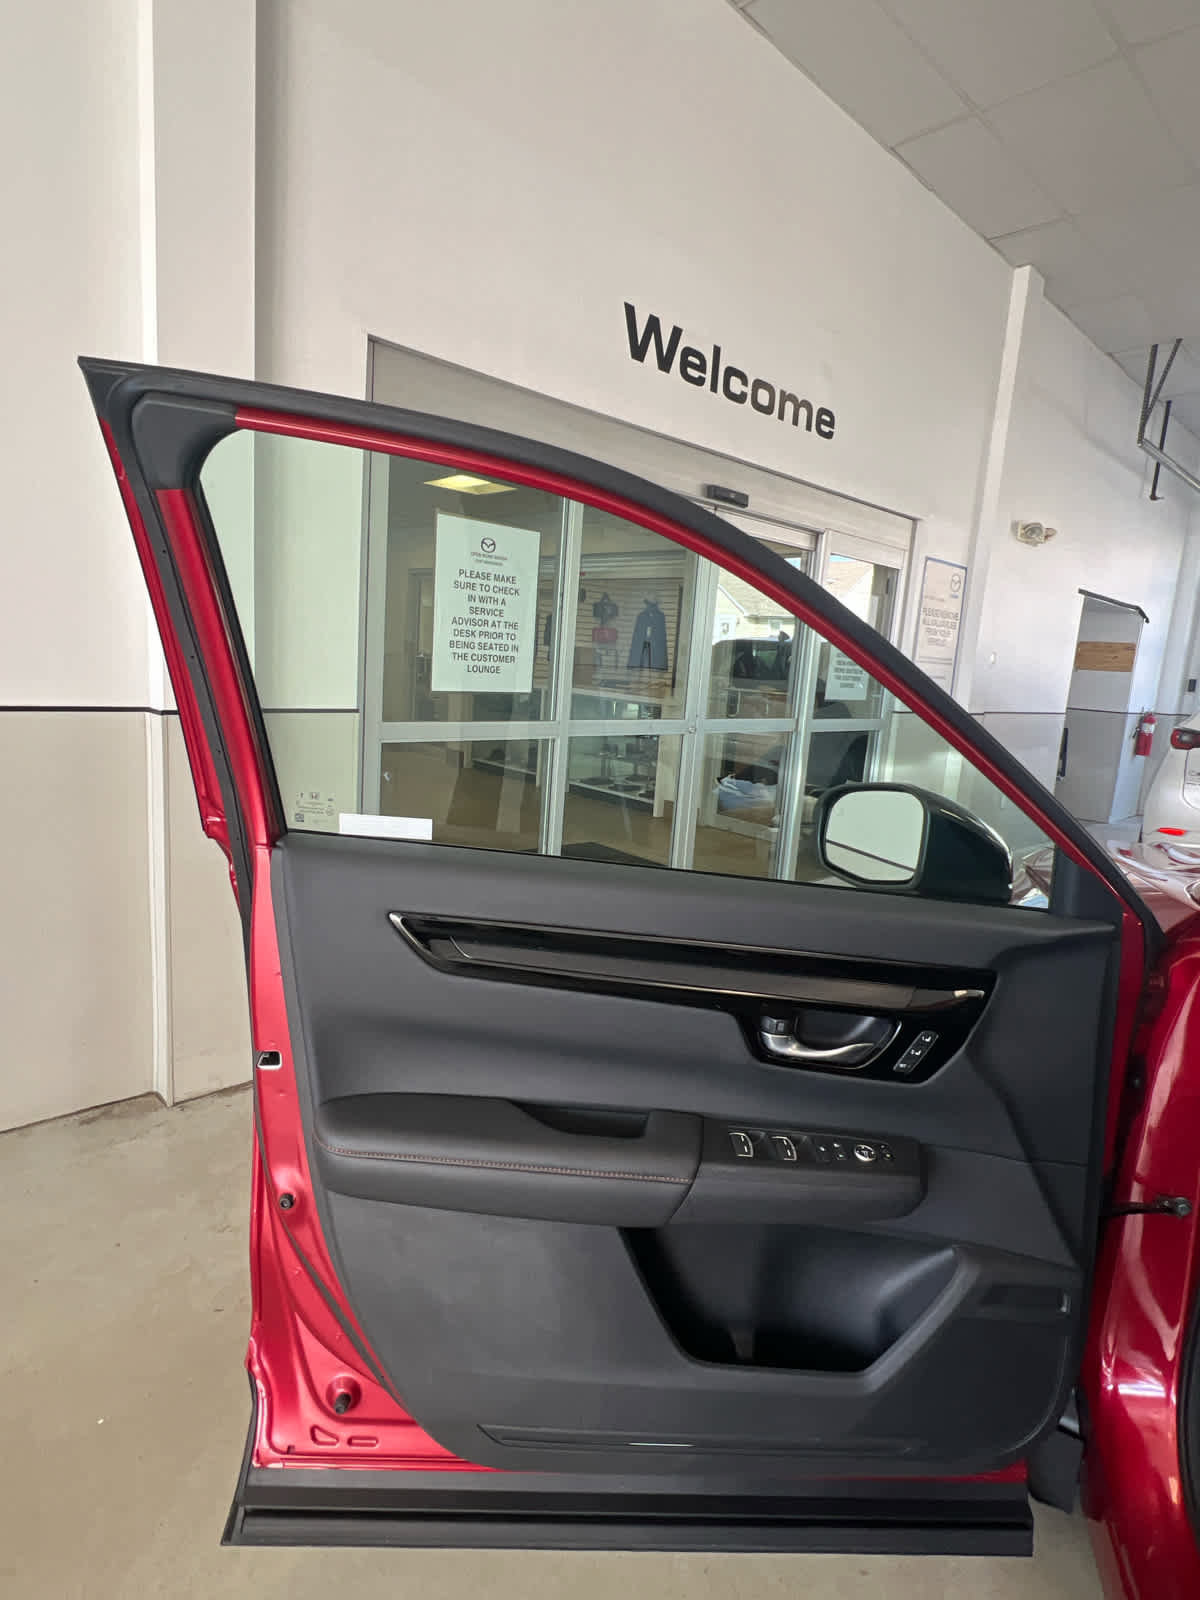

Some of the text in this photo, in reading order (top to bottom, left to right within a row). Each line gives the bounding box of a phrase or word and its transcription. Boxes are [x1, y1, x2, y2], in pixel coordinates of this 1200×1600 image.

[624, 301, 836, 440] Welcome
[459, 569, 517, 584] PLEASE MAKE
[454, 580, 520, 596] SURE TO CHECK
[467, 594, 506, 606] IN WITH A
[469, 606, 504, 617] SERVICE
[451, 616, 519, 630] ADVISOR AT THE
[453, 628, 516, 640] DESK PRIOR TO
[449, 640, 519, 653] BEING SEATED IN
[452, 652, 516, 664] THE CUSTOMER
[467, 664, 501, 674] LOUNGE
